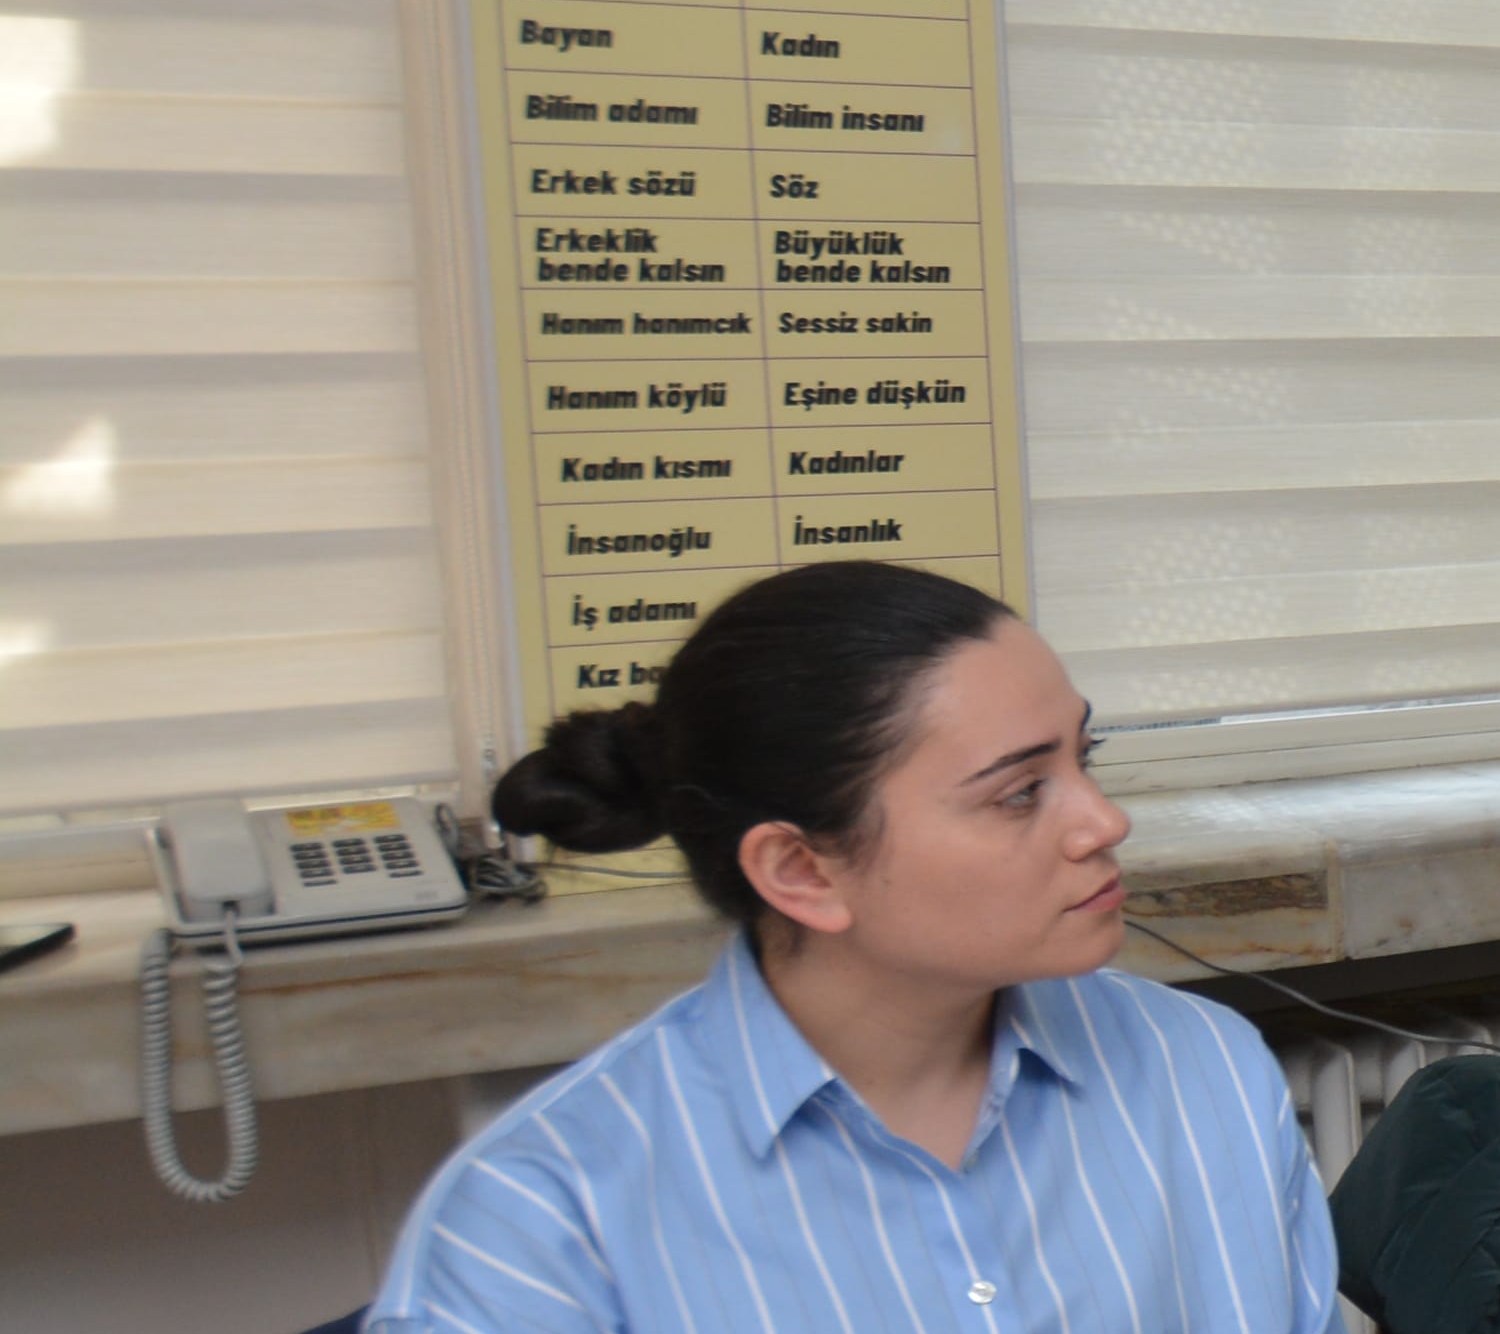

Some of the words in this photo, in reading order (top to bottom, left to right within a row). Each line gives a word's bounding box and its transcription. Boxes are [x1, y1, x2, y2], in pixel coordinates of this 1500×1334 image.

[521, 20, 613, 51] Bayan
[761, 32, 840, 59] Kadın
[526, 94, 597, 121] Bilim
[609, 99, 697, 125] adamı
[766, 104, 833, 129] Bilim
[842, 106, 924, 132] insanı
[531, 169, 618, 195] Erkek
[628, 172, 696, 197] sözü
[770, 174, 818, 199] Söz
[536, 228, 658, 254] Erkeklik
[774, 231, 903, 260] Büyüklük
[538, 260, 627, 282] bende
[638, 260, 725, 283] kalsın
[777, 260, 861, 283] bende
[870, 260, 950, 284] kalsın
[542, 313, 623, 334] Hanım
[634, 312, 752, 334] hanımcık
[779, 311, 857, 334] Sessiz
[866, 311, 932, 333] sakin
[547, 386, 637, 410] Hanım
[648, 383, 726, 413] köylü
[784, 383, 857, 411] Eşine
[866, 380, 965, 409] düşkün
[562, 458, 644, 482] Kadın
[654, 455, 732, 479] kısmı
[789, 451, 904, 475] Kadınlar
[568, 524, 711, 556] İnsanoğlu
[794, 515, 903, 545] İnsanlık
[573, 595, 598, 631] İş
[609, 599, 697, 623] adamı
[577, 664, 620, 688] Kız
